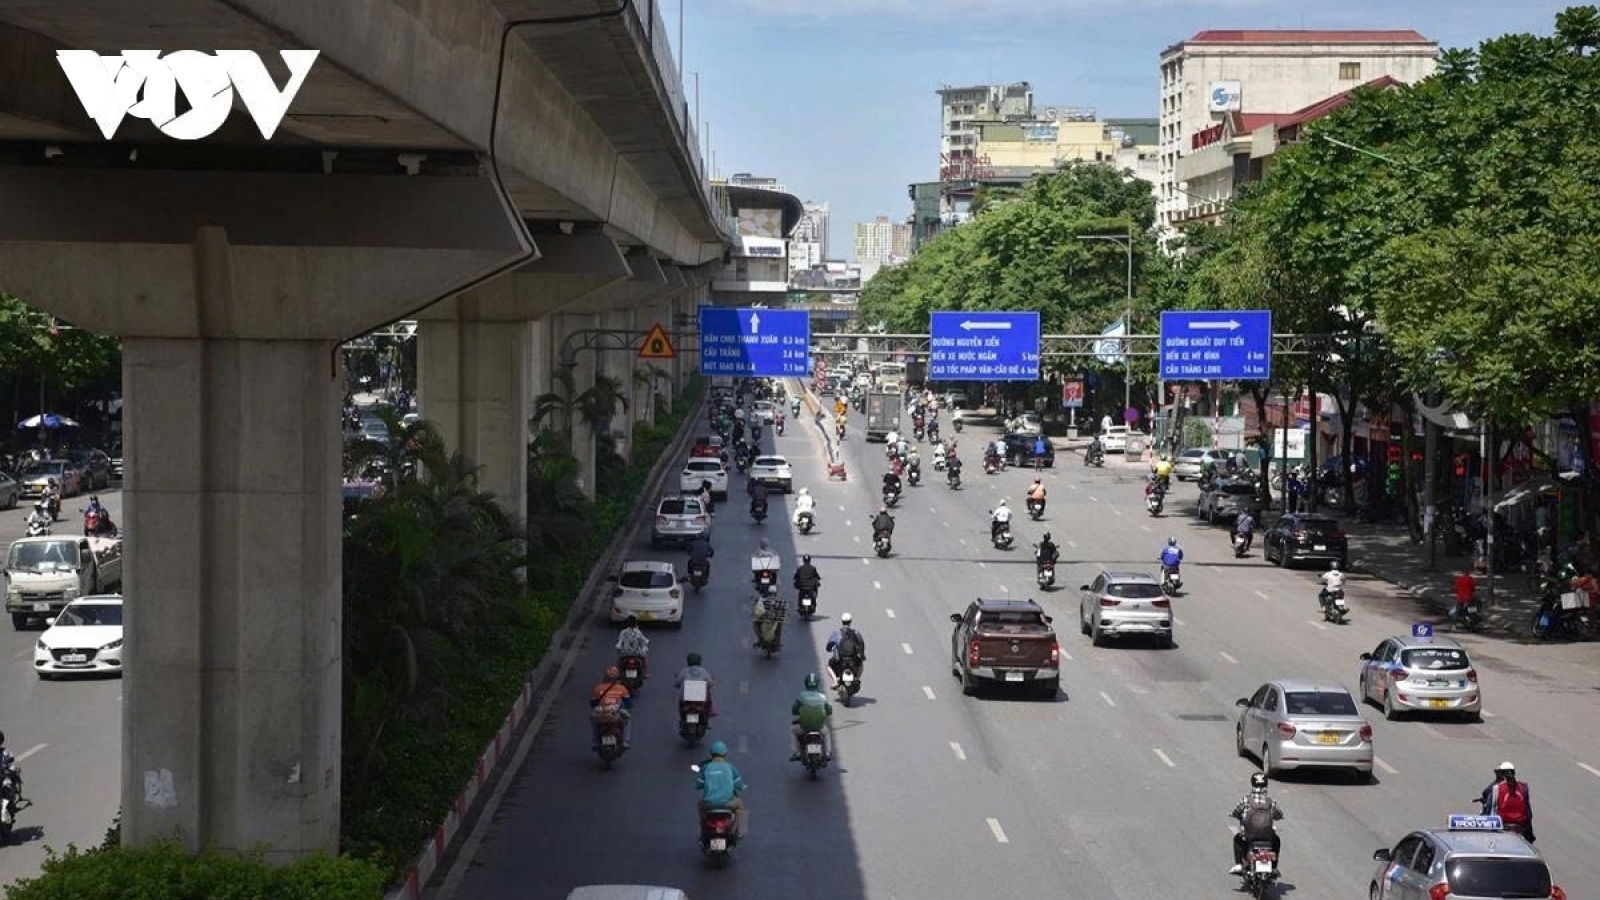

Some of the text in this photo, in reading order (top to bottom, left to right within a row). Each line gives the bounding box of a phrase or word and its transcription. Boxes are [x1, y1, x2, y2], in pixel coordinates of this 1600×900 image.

[795, 336, 805, 345] km
[1214, 337, 1227, 347] DUY
[795, 349, 805, 359] km
[948, 351, 957, 361] XE
[1181, 351, 1190, 360] XE
[1253, 351, 1264, 360] km
[795, 362, 805, 373] km
[1204, 365, 1221, 374] LONG
[1243, 365, 1252, 374] 14
[1253, 365, 1264, 374] km
